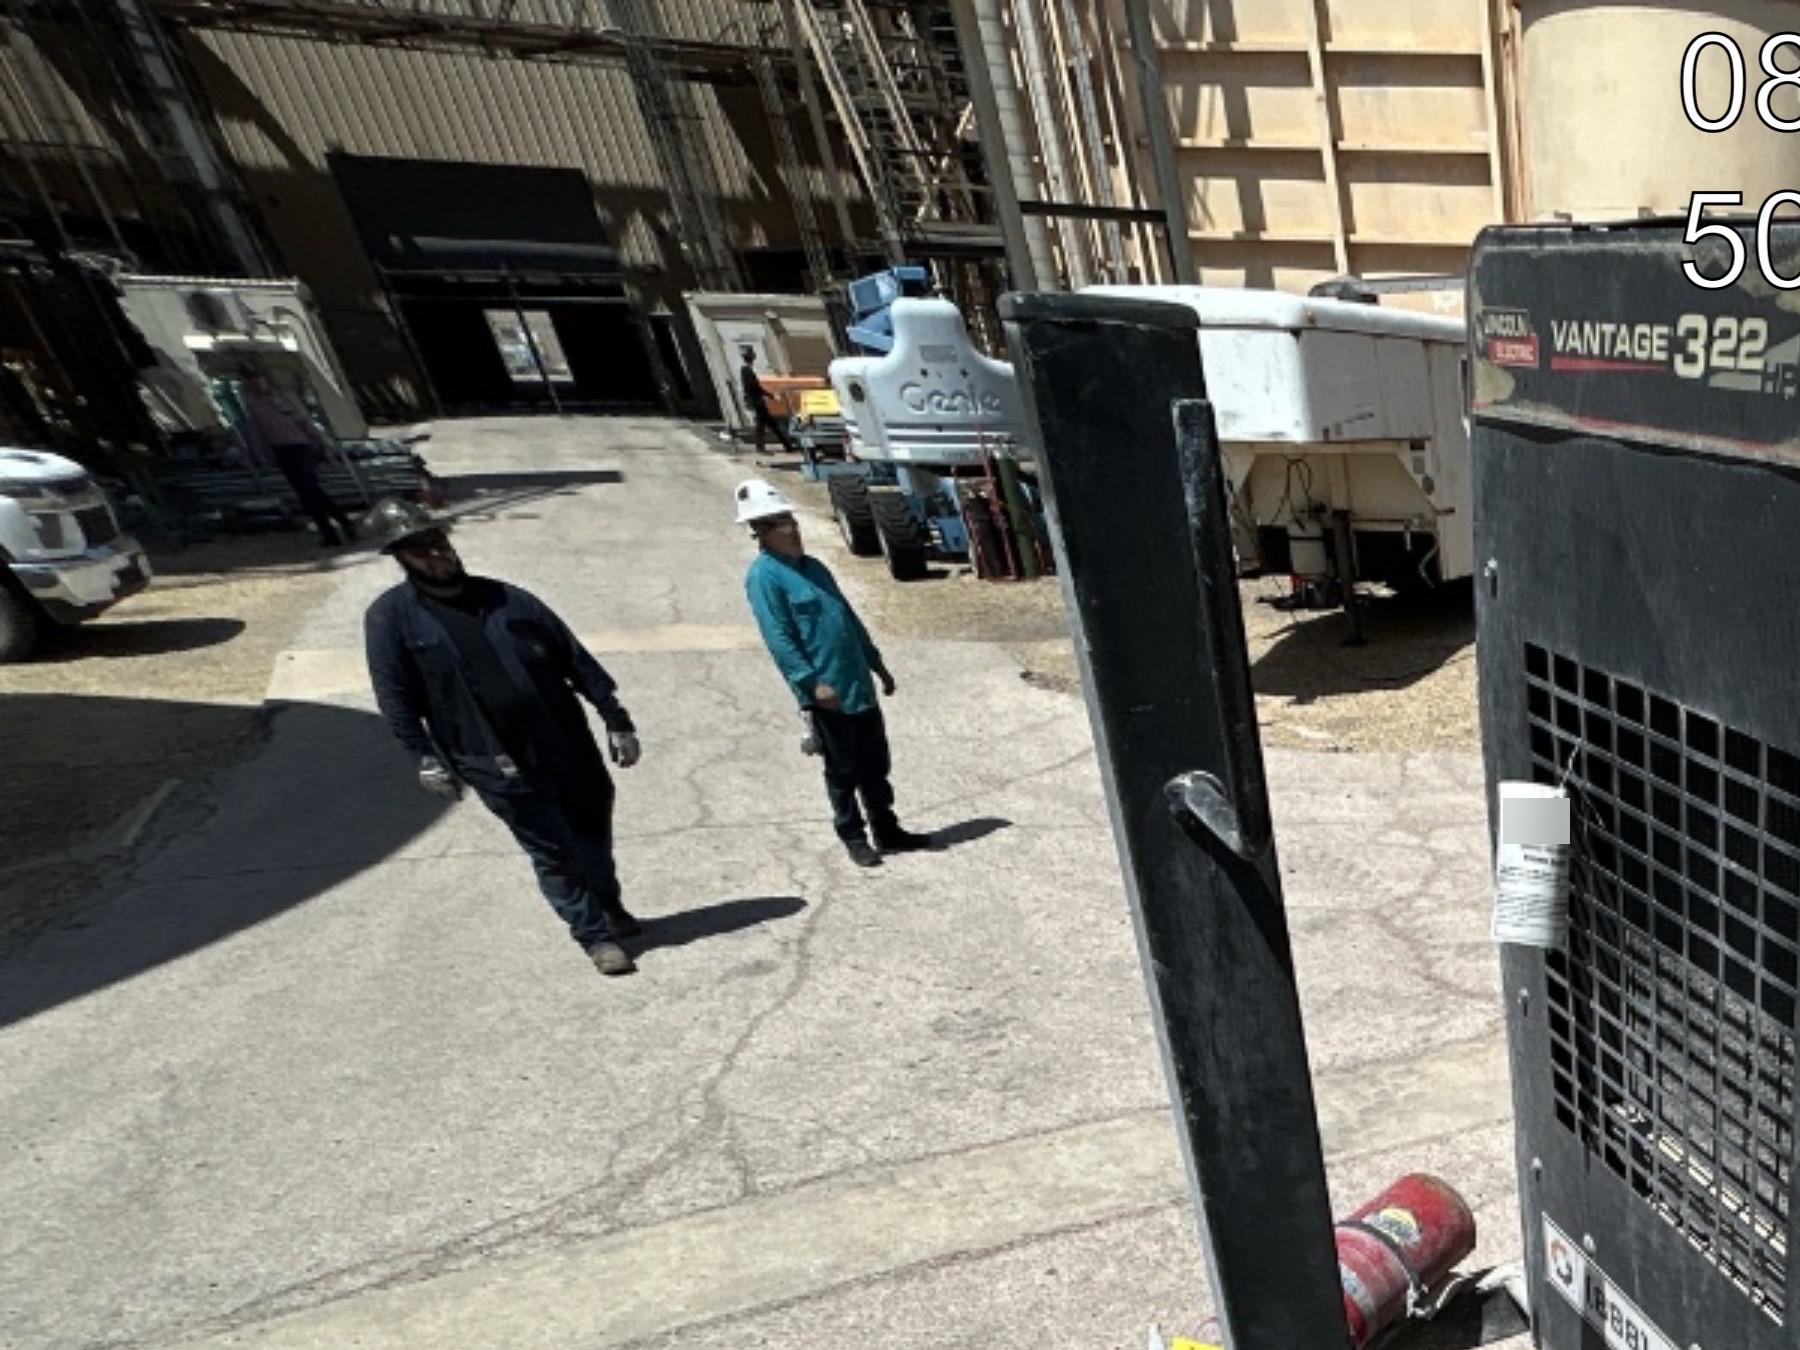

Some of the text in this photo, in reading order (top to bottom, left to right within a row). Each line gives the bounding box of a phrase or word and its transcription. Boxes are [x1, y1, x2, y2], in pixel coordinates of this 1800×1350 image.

[1551, 319, 1670, 361] VANTAGE
[1673, 313, 1769, 379] 322
[899, 380, 1003, 416] Genie
